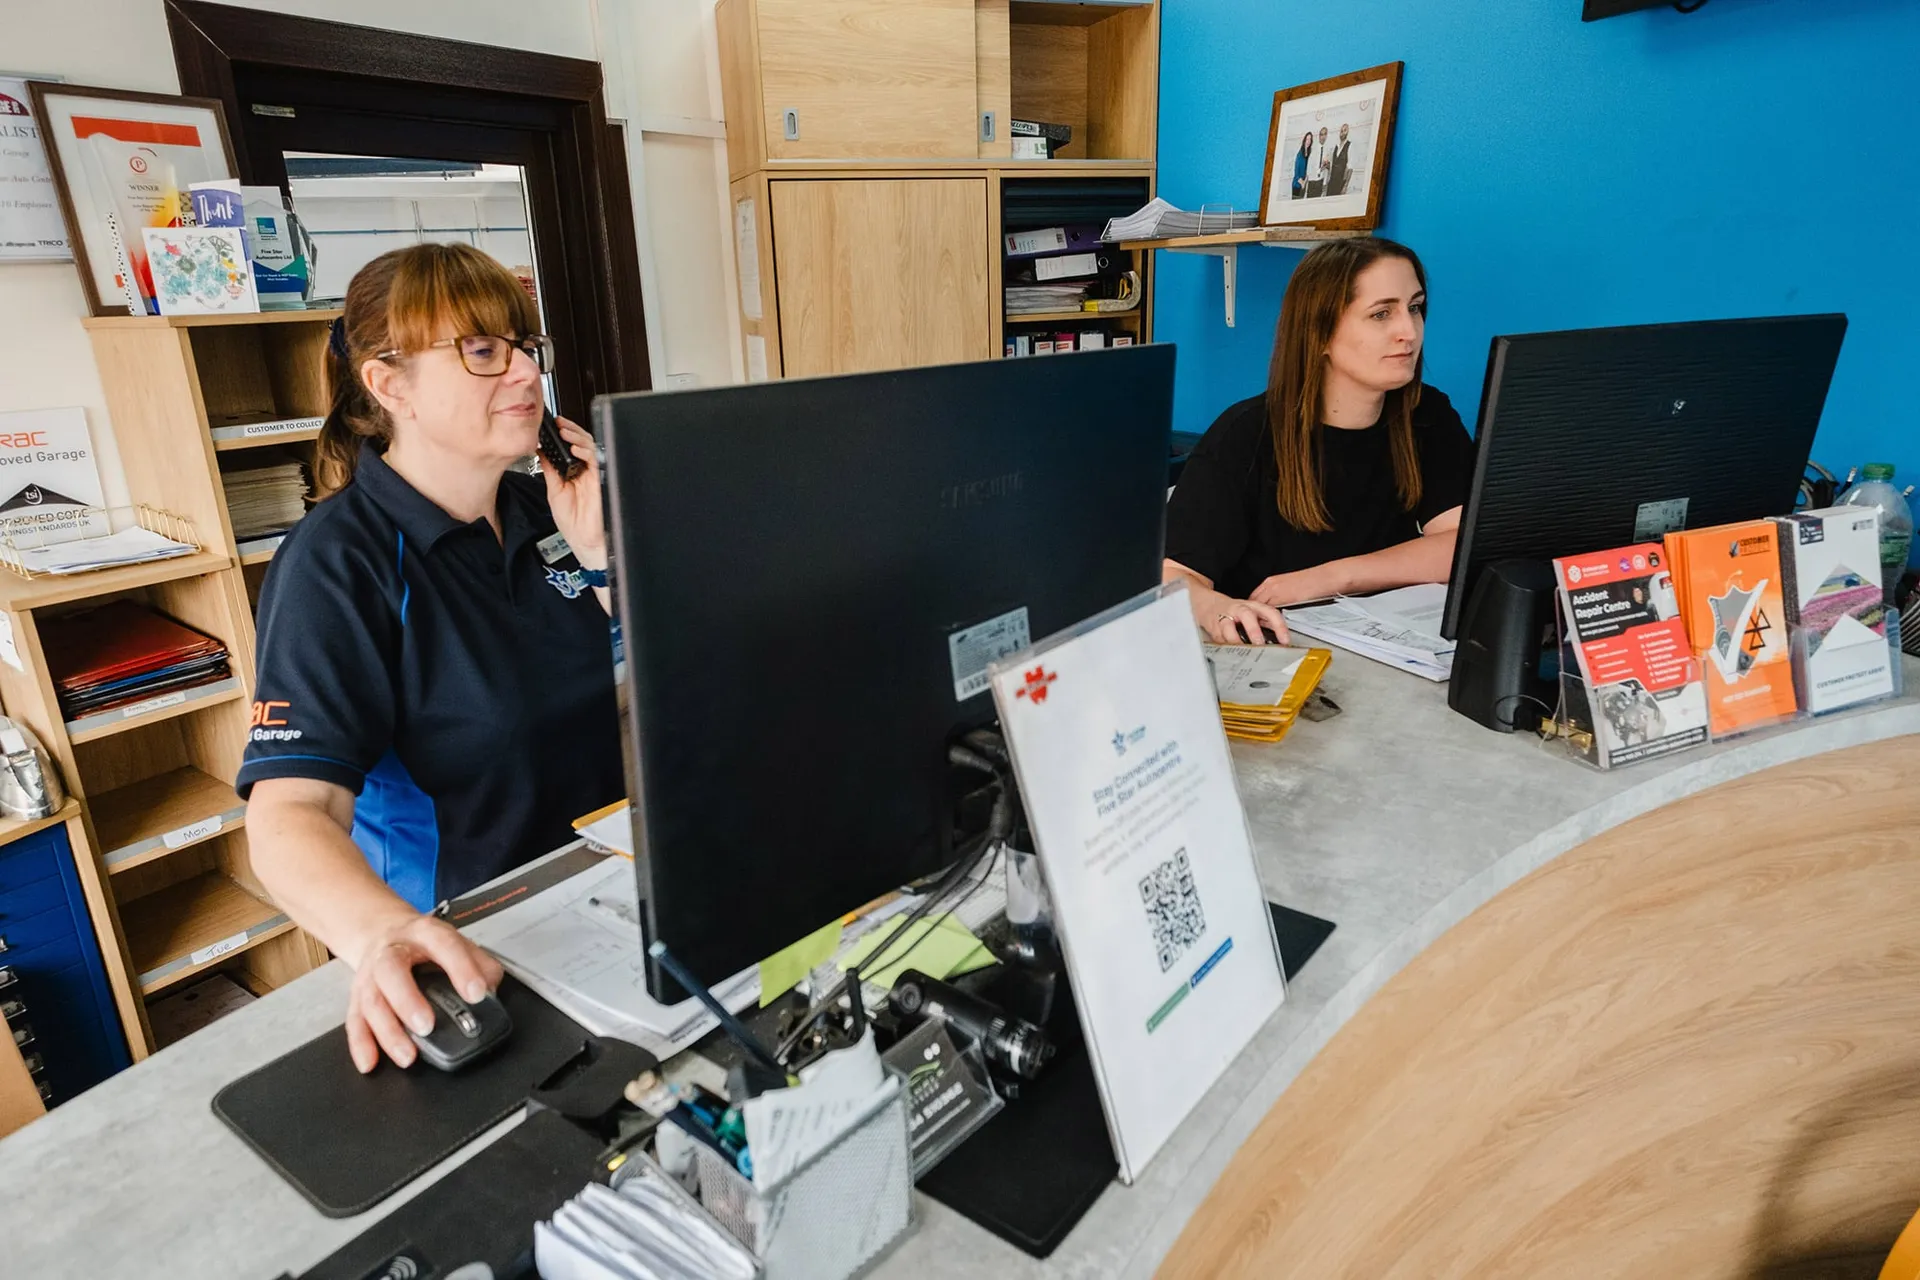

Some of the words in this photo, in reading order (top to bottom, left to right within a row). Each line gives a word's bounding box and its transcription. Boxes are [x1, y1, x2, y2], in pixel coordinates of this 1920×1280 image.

[129, 184, 160, 192] WINNER
[197, 194, 235, 227] Thank
[247, 424, 285, 434] CUSTOMER
[296, 420, 323, 429] COLLECT
[36, 450, 87, 462] Garage
[25, 489, 38, 500] tsi
[1573, 590, 1609, 605] Accident
[1575, 605, 1603, 619] Repair
[1604, 601, 1631, 613] Centre
[254, 729, 302, 741] Garage
[1093, 785, 1114, 803] Stay
[1114, 751, 1160, 789] Connected
[1161, 740, 1178, 757] with
[1097, 800, 1116, 817] Five
[1117, 786, 1136, 804] Star
[1137, 754, 1182, 789] Autocentre
[183, 827, 208, 841] Mon
[205, 943, 232, 958] Tue
